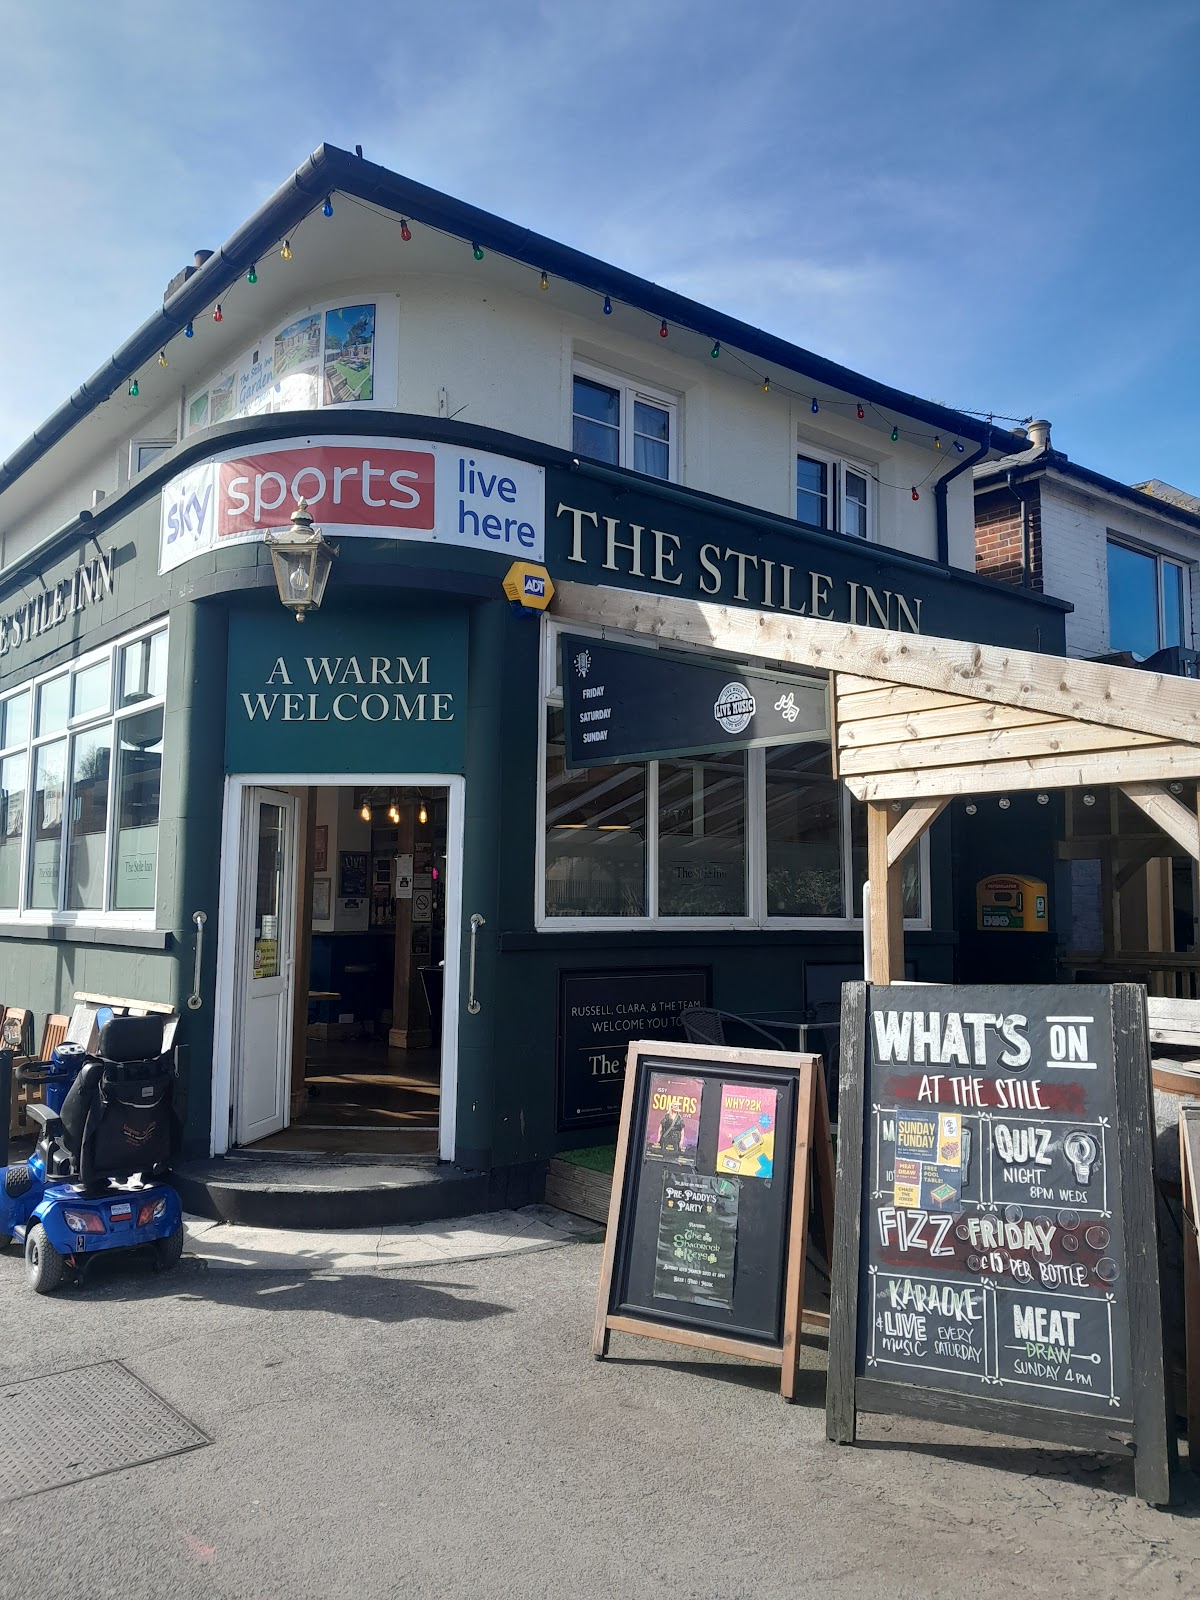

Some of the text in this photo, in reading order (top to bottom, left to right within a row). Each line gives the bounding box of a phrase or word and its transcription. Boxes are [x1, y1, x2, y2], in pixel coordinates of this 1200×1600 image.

[240, 371, 273, 404] Garden
[459, 458, 517, 503] live
[167, 460, 421, 545] sky sports
[459, 499, 536, 548] here
[556, 502, 923, 634] THE STILE INN
[10, 576, 67, 648] STILE
[67, 546, 117, 615] INN
[524, 578, 546, 594] ADT
[265, 656, 431, 685] A WARM
[582, 685, 605, 700] FRIDAY
[240, 692, 455, 722] WELCOME
[579, 707, 612, 723] SATURDAY
[716, 698, 754, 718] LIVE MUSIC
[582, 729, 608, 744] SUNDAY
[675, 866, 693, 879] The
[571, 1000, 700, 1017] RUSSELL, CLARA, & THE TEAM
[591, 1016, 683, 1032] WELCOME YOU TO
[871, 1010, 1089, 1069] WHAT'S ON
[588, 1054, 620, 1076] The
[652, 1093, 697, 1114] SOMERS
[917, 1074, 1051, 1111] AT THE STILE
[898, 1120, 935, 1136] SUNDAY
[898, 1133, 935, 1149] FUNDAY
[994, 1124, 1052, 1166] QUIZ
[923, 1171, 940, 1179] POOL
[1003, 1168, 1047, 1186] NIGHT
[666, 1187, 717, 1204] PRE-PADDY'S
[1029, 1186, 1088, 1204] 8PM WEDS
[677, 1201, 703, 1213] PARTY
[684, 1229, 702, 1241] The
[877, 1206, 1057, 1258] FIZZ FRIDAY
[1009, 1259, 1035, 1281] PER
[1039, 1262, 1090, 1288] BOTTLE
[888, 1278, 983, 1326] KARAOKE
[884, 1310, 928, 1342] LIVE
[937, 1325, 975, 1345] EVERY
[1013, 1304, 1081, 1348] MEAT
[934, 1339, 983, 1364] SATURDAY
[1026, 1340, 1071, 1365] DRAW
[1013, 1358, 1061, 1382] SUNDAY
